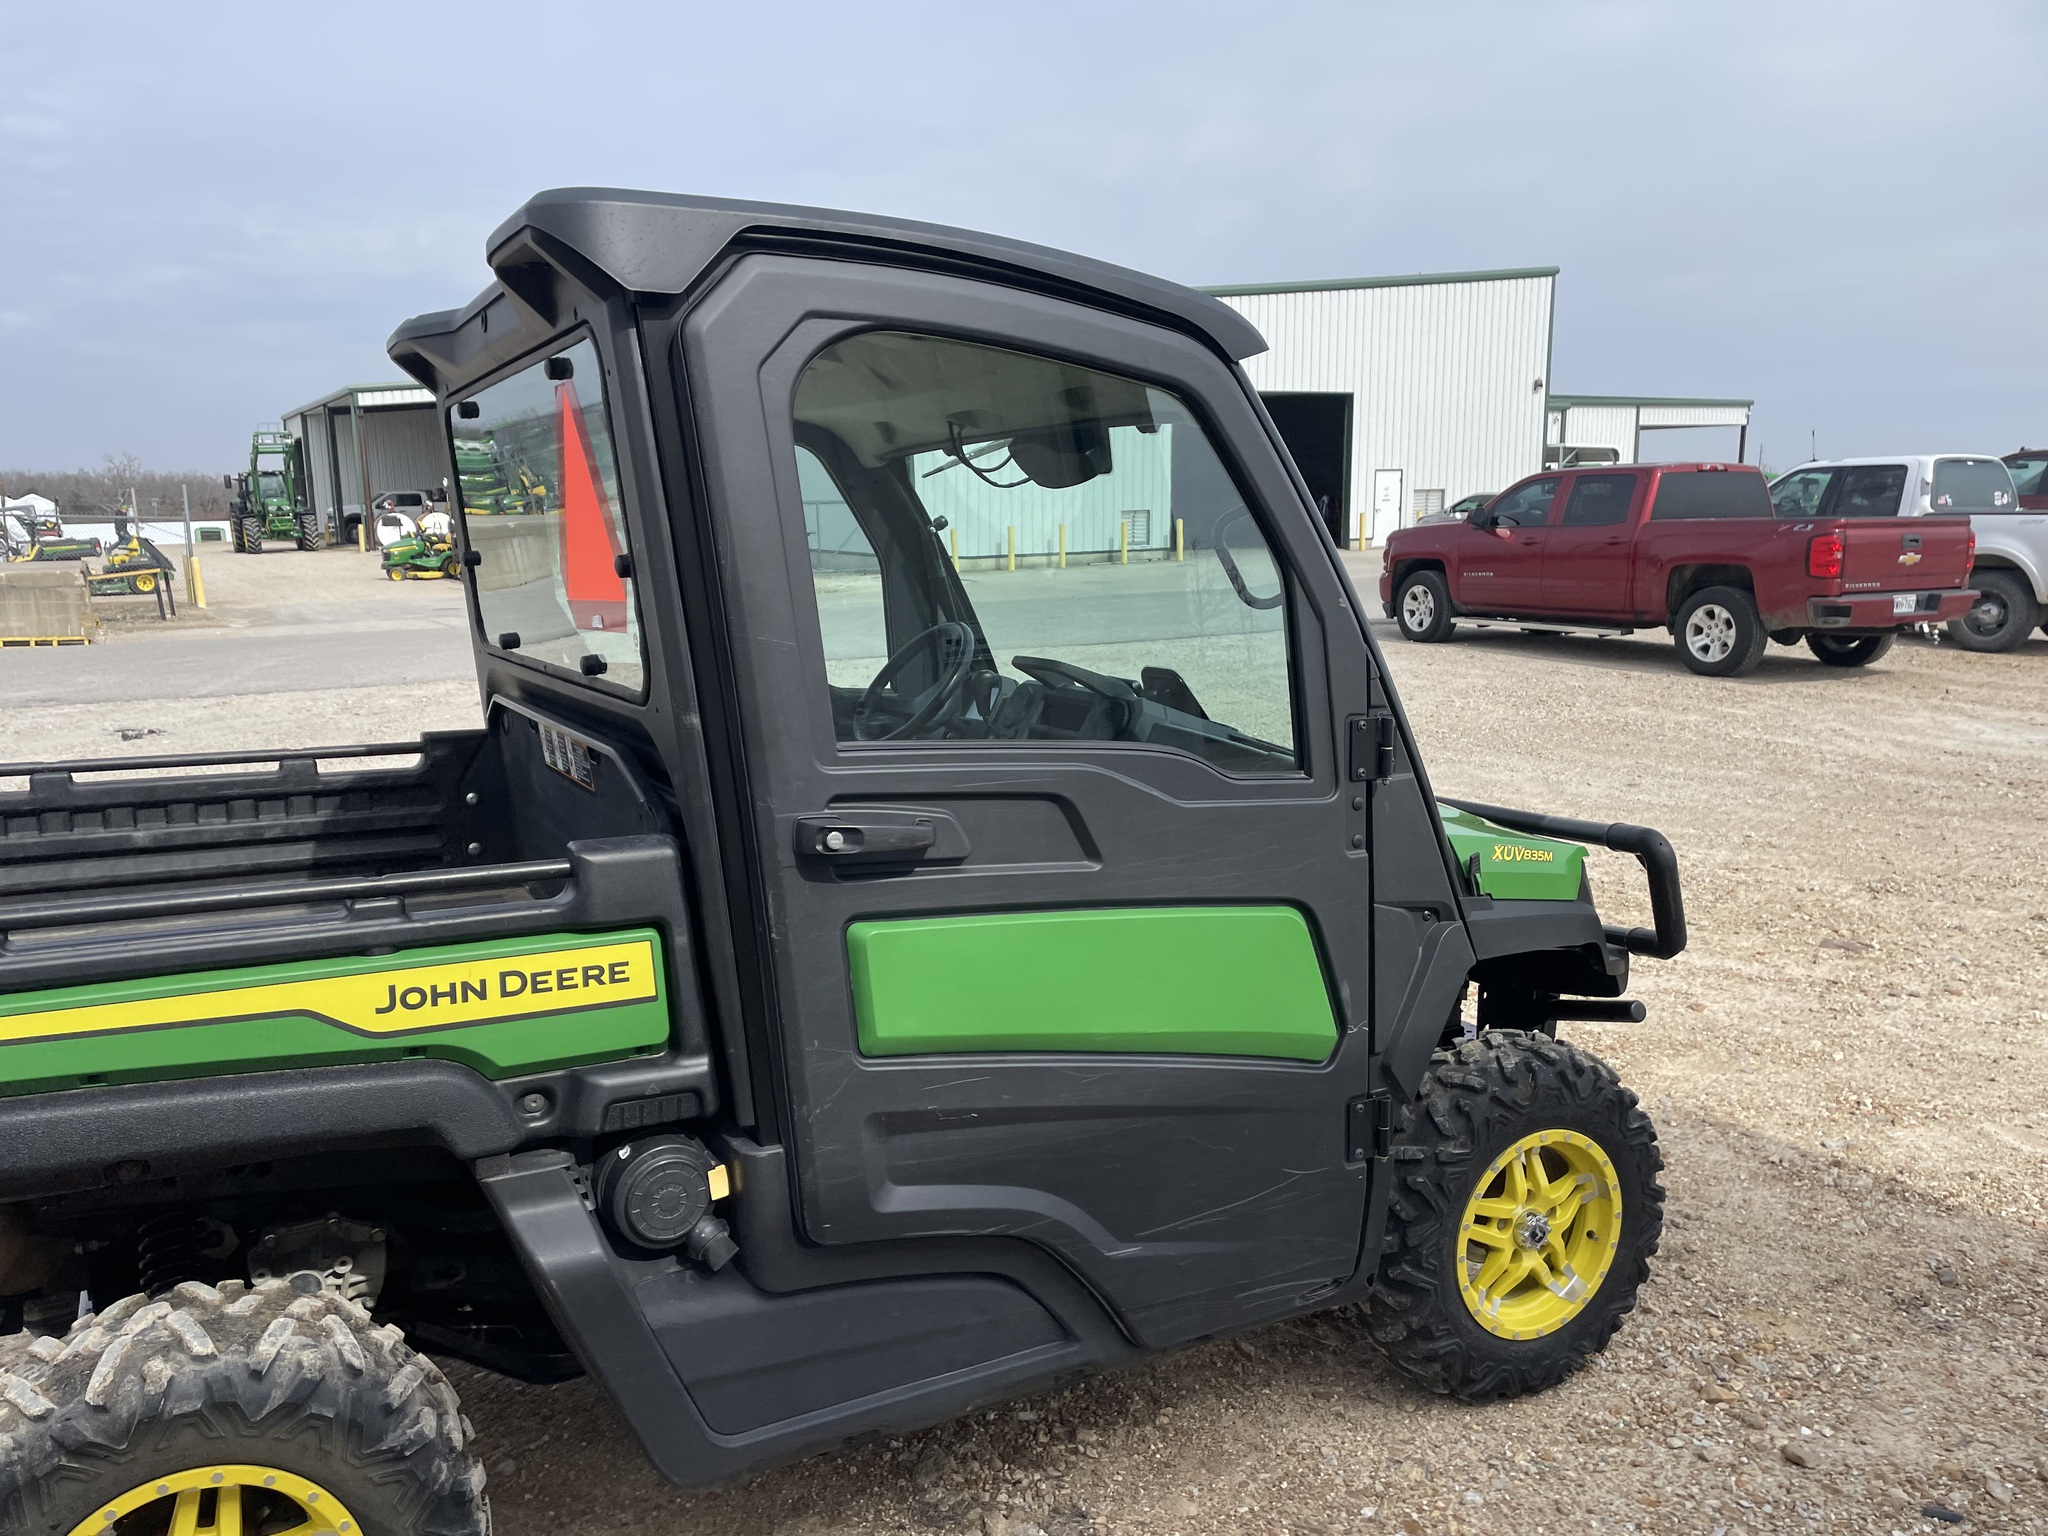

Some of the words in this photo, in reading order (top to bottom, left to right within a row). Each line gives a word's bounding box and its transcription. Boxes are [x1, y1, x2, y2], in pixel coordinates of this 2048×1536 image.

[1491, 844, 1553, 862] XUV835M
[375, 978, 487, 1014] JOHN
[499, 961, 630, 998] DEERE
